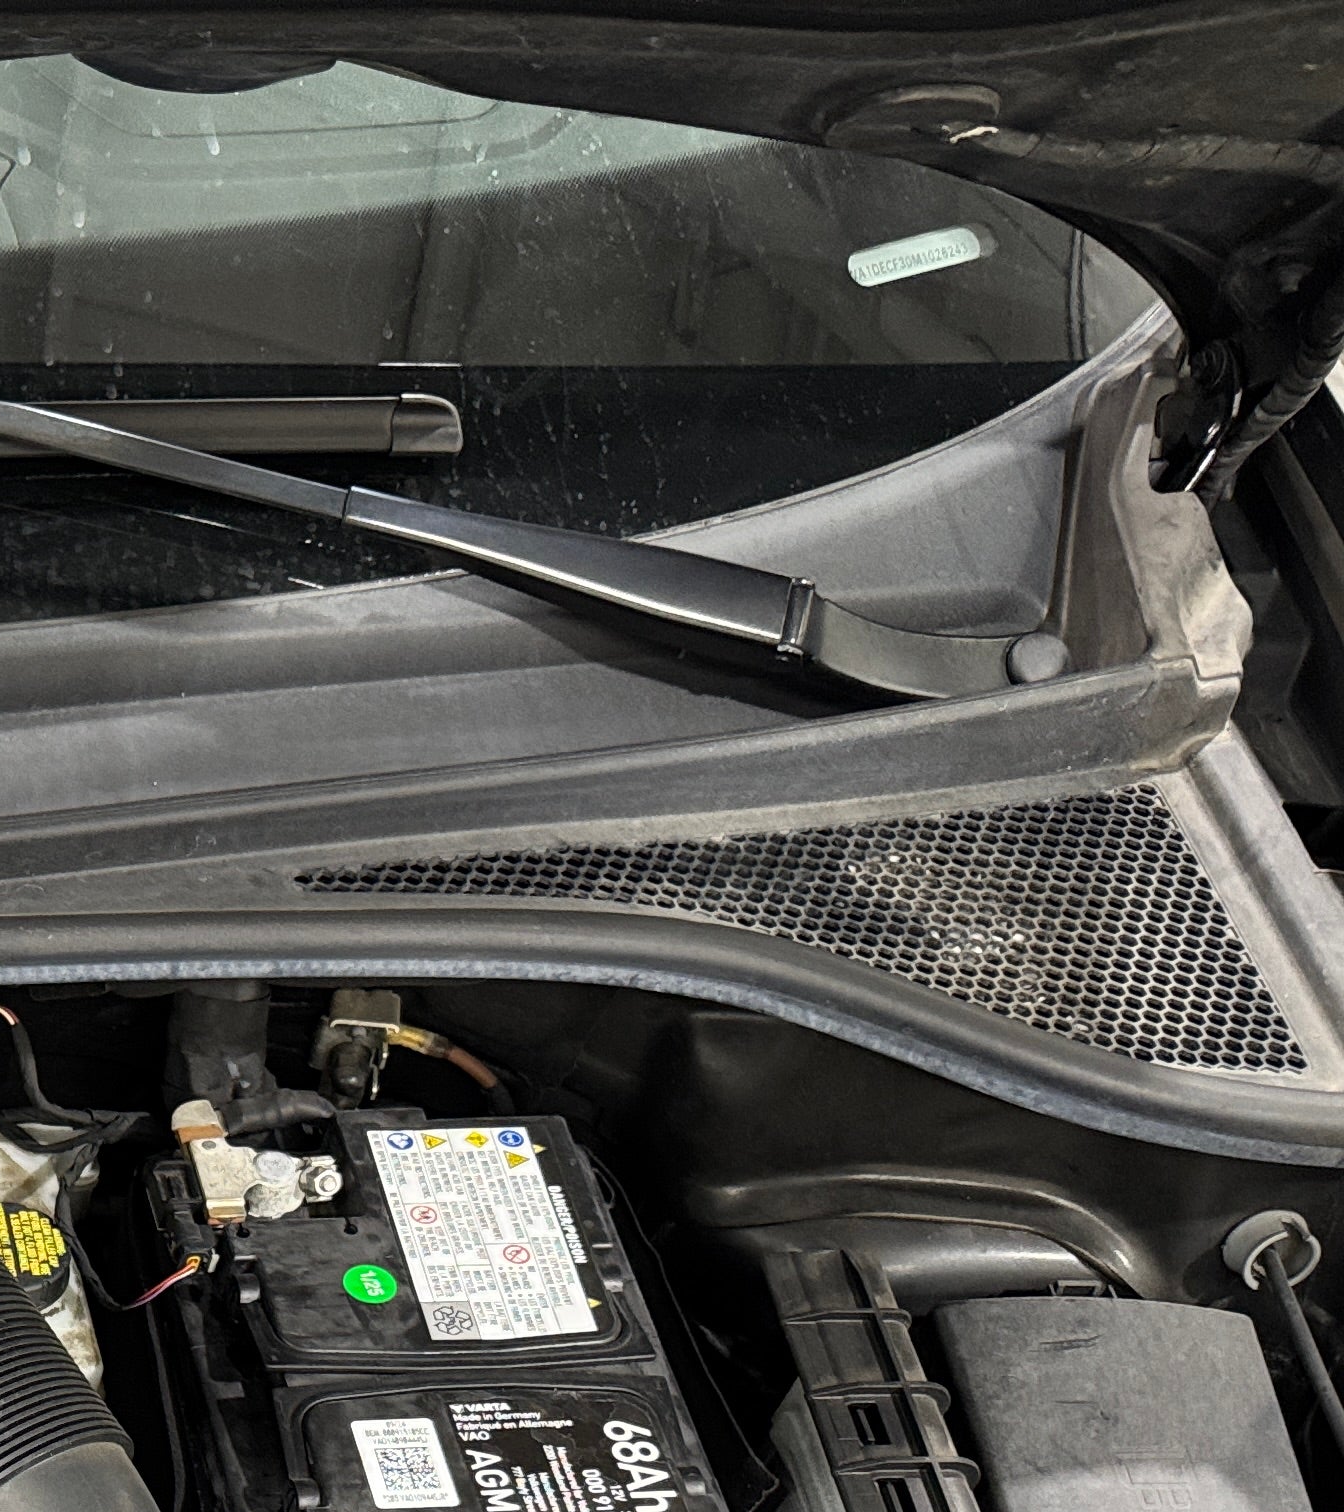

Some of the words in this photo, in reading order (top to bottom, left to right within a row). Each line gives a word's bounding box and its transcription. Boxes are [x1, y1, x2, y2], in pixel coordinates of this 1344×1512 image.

[546, 1185, 587, 1263] DANGER/POISON
[358, 1269, 384, 1297] 1/25
[452, 1413, 481, 1421] Made
[483, 1412, 492, 1420] in
[495, 1411, 540, 1421] Germany
[466, 1402, 510, 1412] VARTA
[518, 1420, 573, 1428] Allemagne
[580, 1468, 607, 1494] 000
[609, 1484, 627, 1502] 12V
